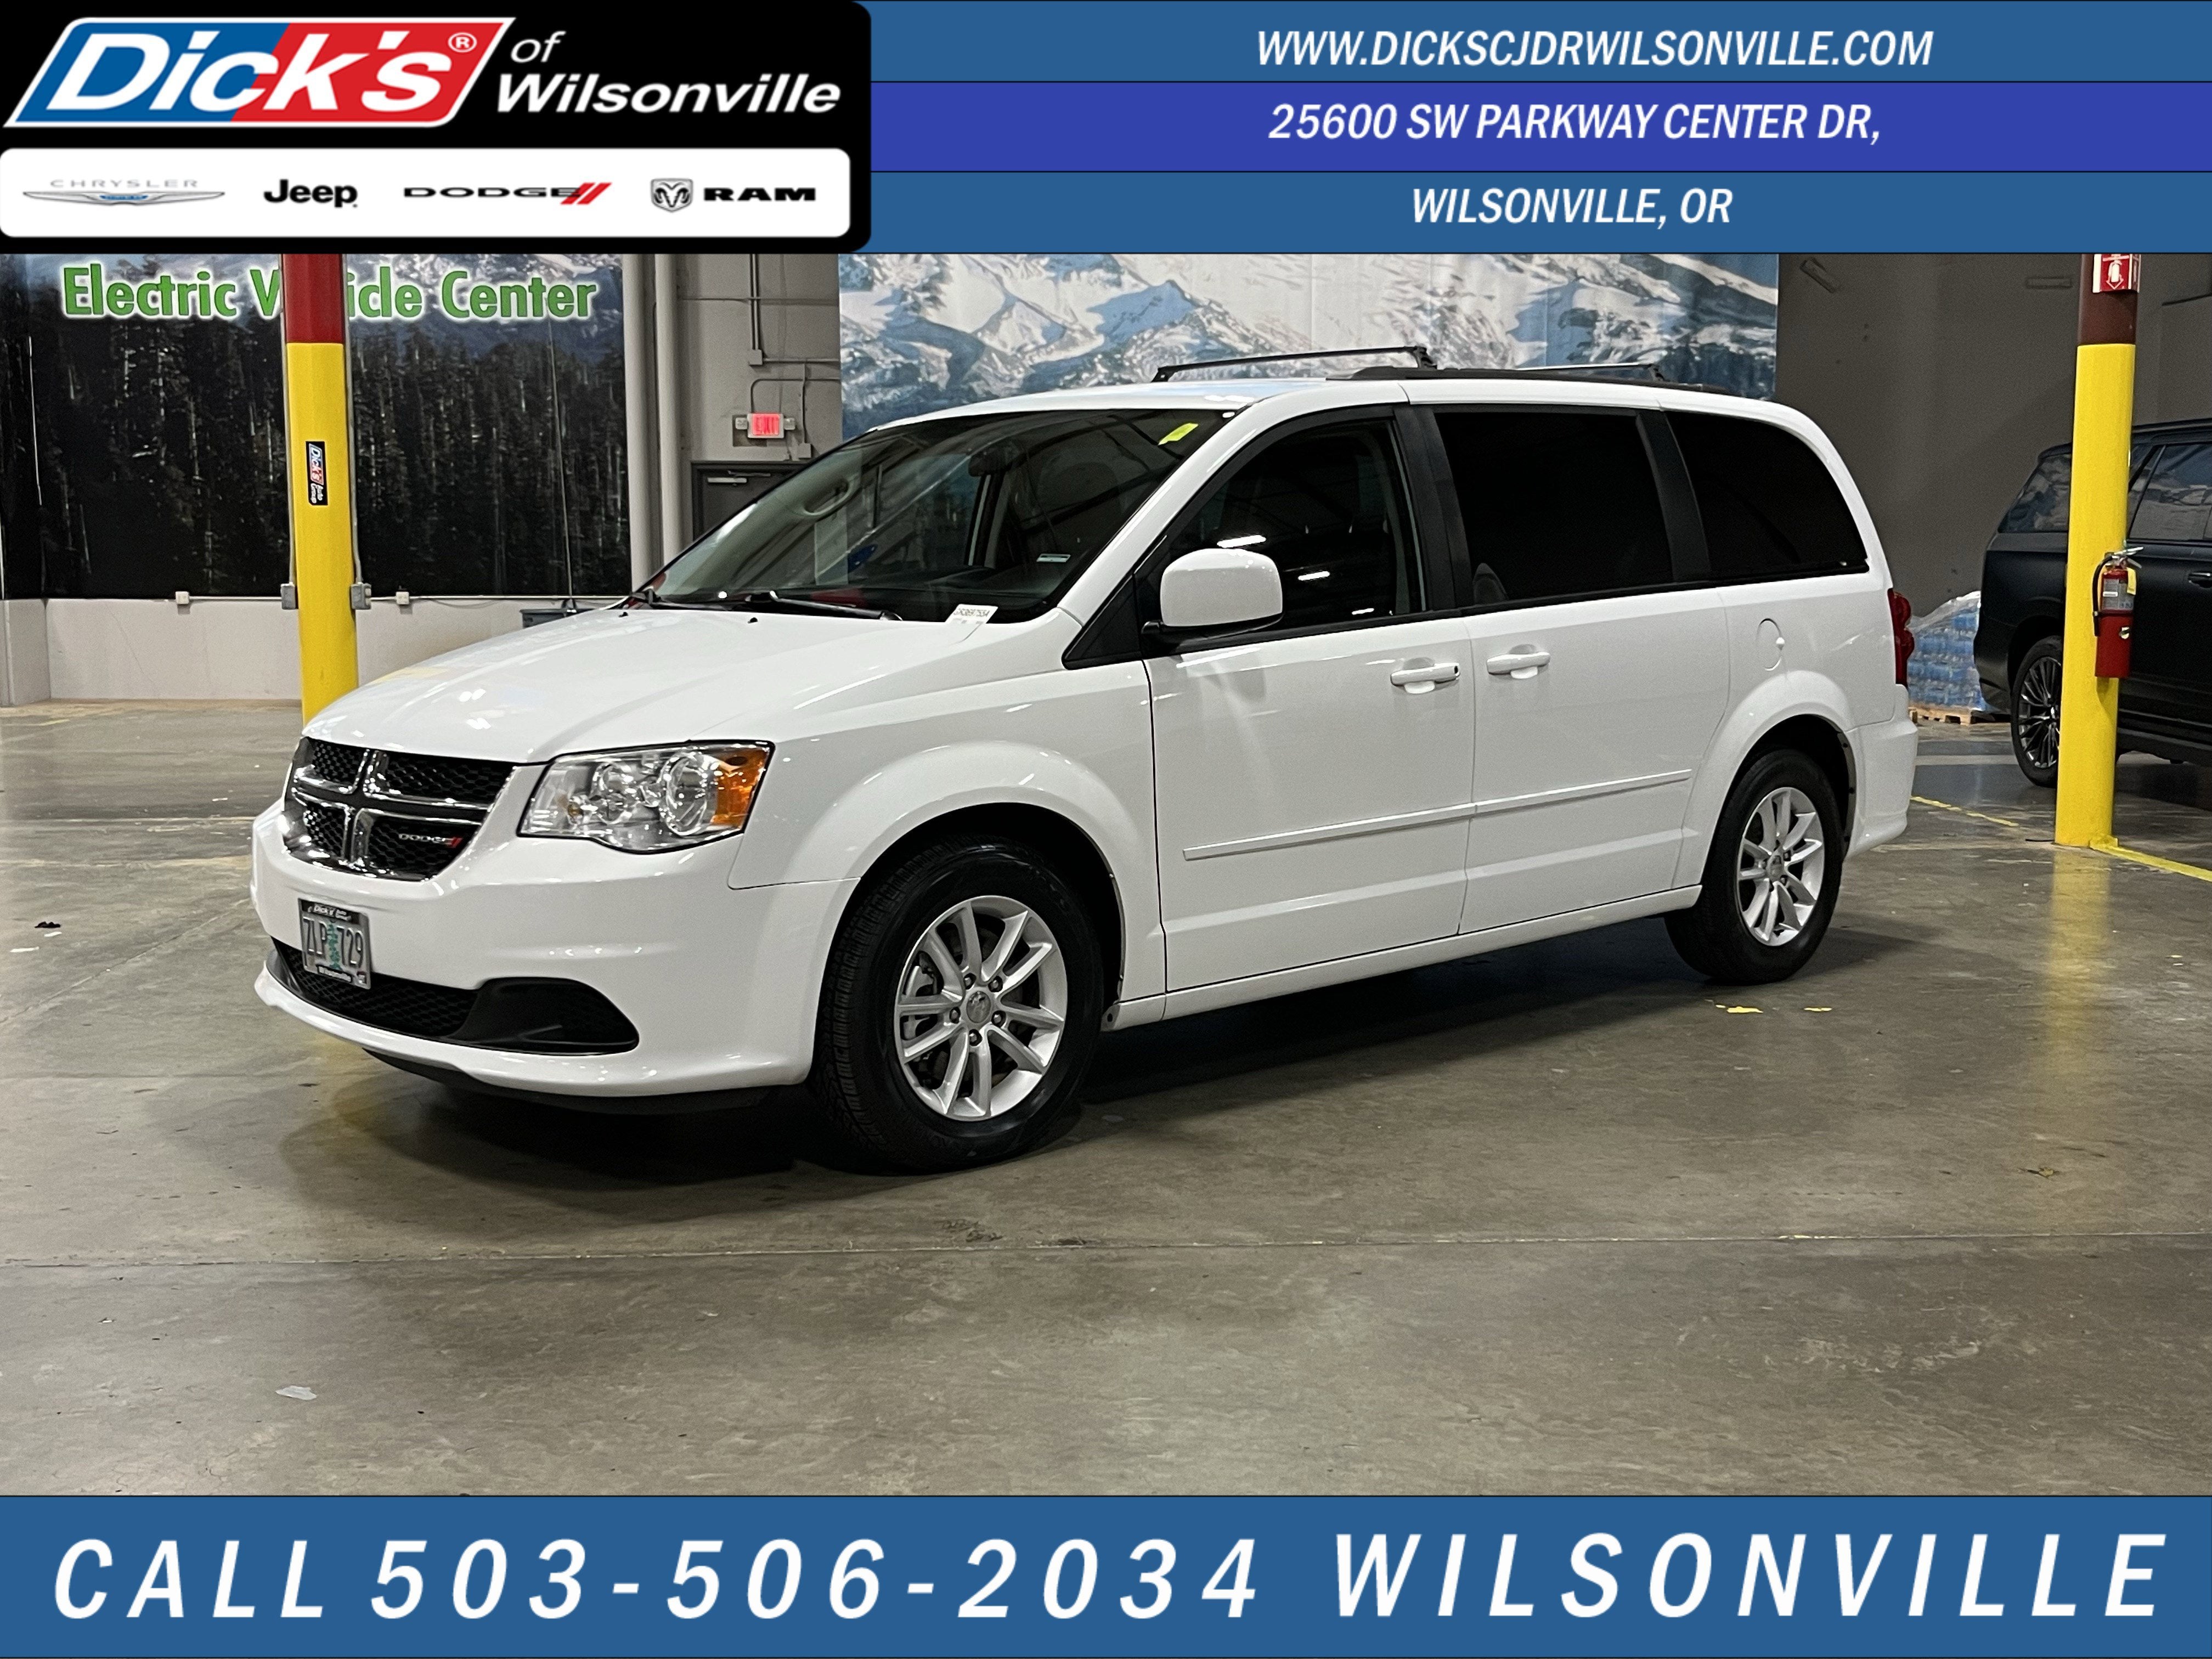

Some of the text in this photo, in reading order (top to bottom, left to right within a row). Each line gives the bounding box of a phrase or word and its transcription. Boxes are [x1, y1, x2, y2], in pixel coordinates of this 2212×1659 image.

[63, 263, 597, 317] Electric Vicle Center
[336, 925, 364, 969] 729
